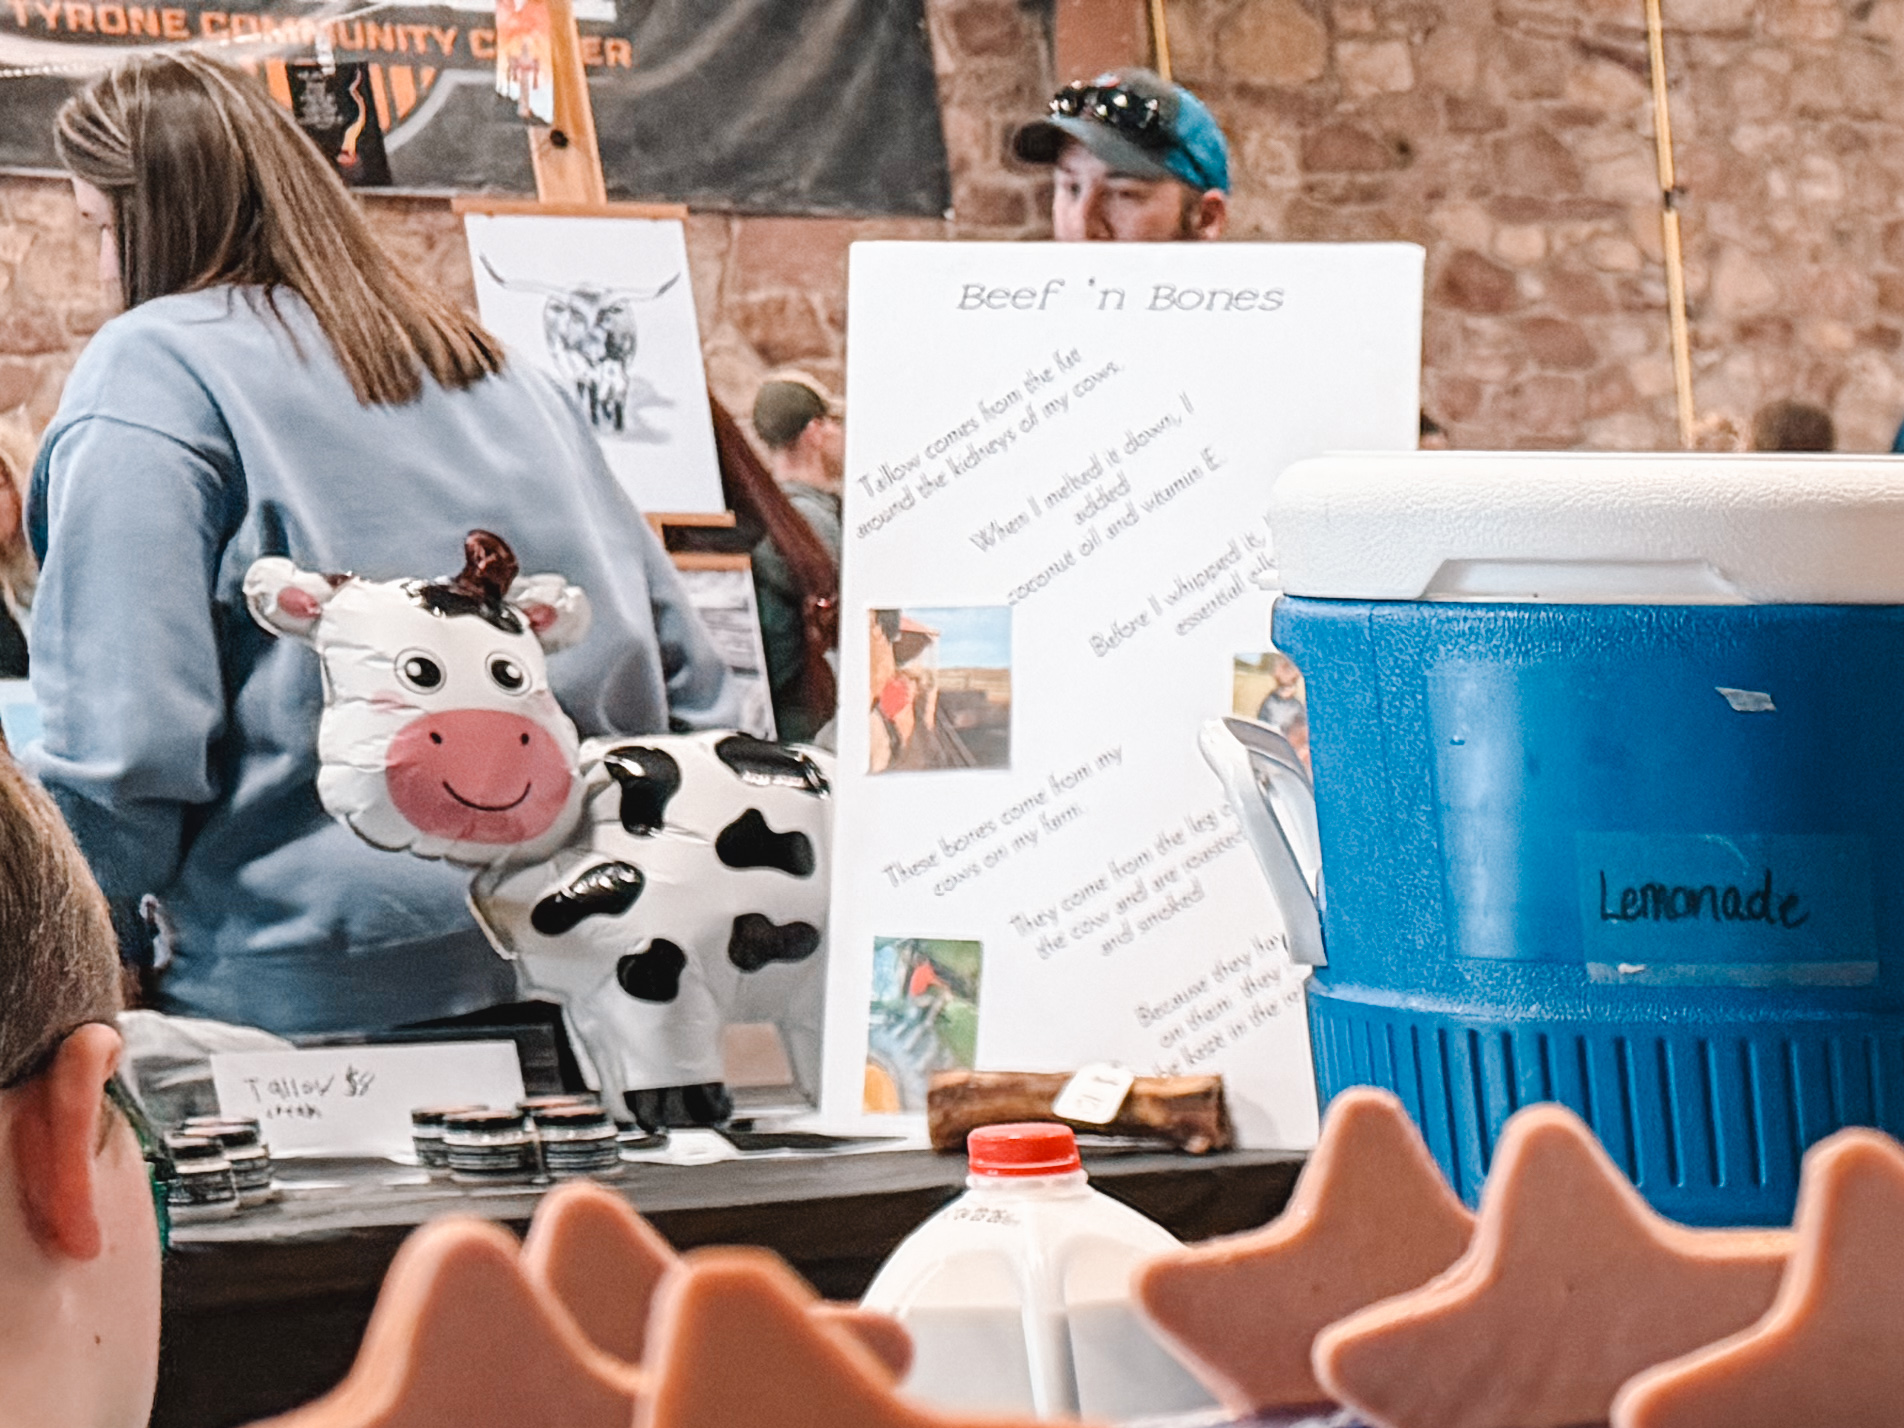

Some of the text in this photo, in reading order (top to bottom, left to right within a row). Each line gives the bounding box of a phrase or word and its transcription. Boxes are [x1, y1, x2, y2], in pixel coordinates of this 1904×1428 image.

[956, 277, 1066, 312] Beef
[1146, 282, 1285, 312] Bones
[856, 484, 916, 539] around
[916, 468, 949, 500] the
[945, 428, 1017, 479] kidneys
[1019, 402, 1040, 434] of
[1041, 392, 1070, 421] my
[858, 456, 921, 498] Tallow
[924, 417, 980, 460] comes
[977, 390, 1023, 422] from
[1023, 365, 1055, 394] the
[968, 511, 1031, 553] When
[1043, 451, 1104, 510] melted
[1105, 447, 1123, 468] it
[1006, 549, 1077, 606] coconut
[1078, 523, 1102, 557] oil
[1105, 498, 1140, 540] and
[1140, 464, 1204, 513] vitamin
[1074, 469, 1132, 526] added
[1088, 610, 1151, 658] Before
[1163, 537, 1243, 607] whipped
[1175, 569, 1245, 636] essential
[881, 744, 1123, 888] These bones come from my
[932, 861, 982, 898] cows
[983, 848, 1009, 869] on
[1011, 828, 1039, 853] my
[1007, 906, 1060, 938] They
[1060, 876, 1109, 913] come
[1107, 848, 1155, 883] from
[1153, 828, 1187, 856] the
[1183, 809, 1219, 836] leg
[1599, 867, 1812, 930] Lemonade
[1035, 933, 1069, 961] the
[1069, 908, 1111, 941] cow
[1114, 875, 1149, 915] and
[1151, 866, 1179, 894] are
[1100, 917, 1135, 957] and
[1134, 974, 1208, 1029] Because
[1211, 950, 1253, 984] they
[1158, 1022, 1186, 1049] on
[1239, 965, 1281, 999] they
[1248, 999, 1281, 1027] the
